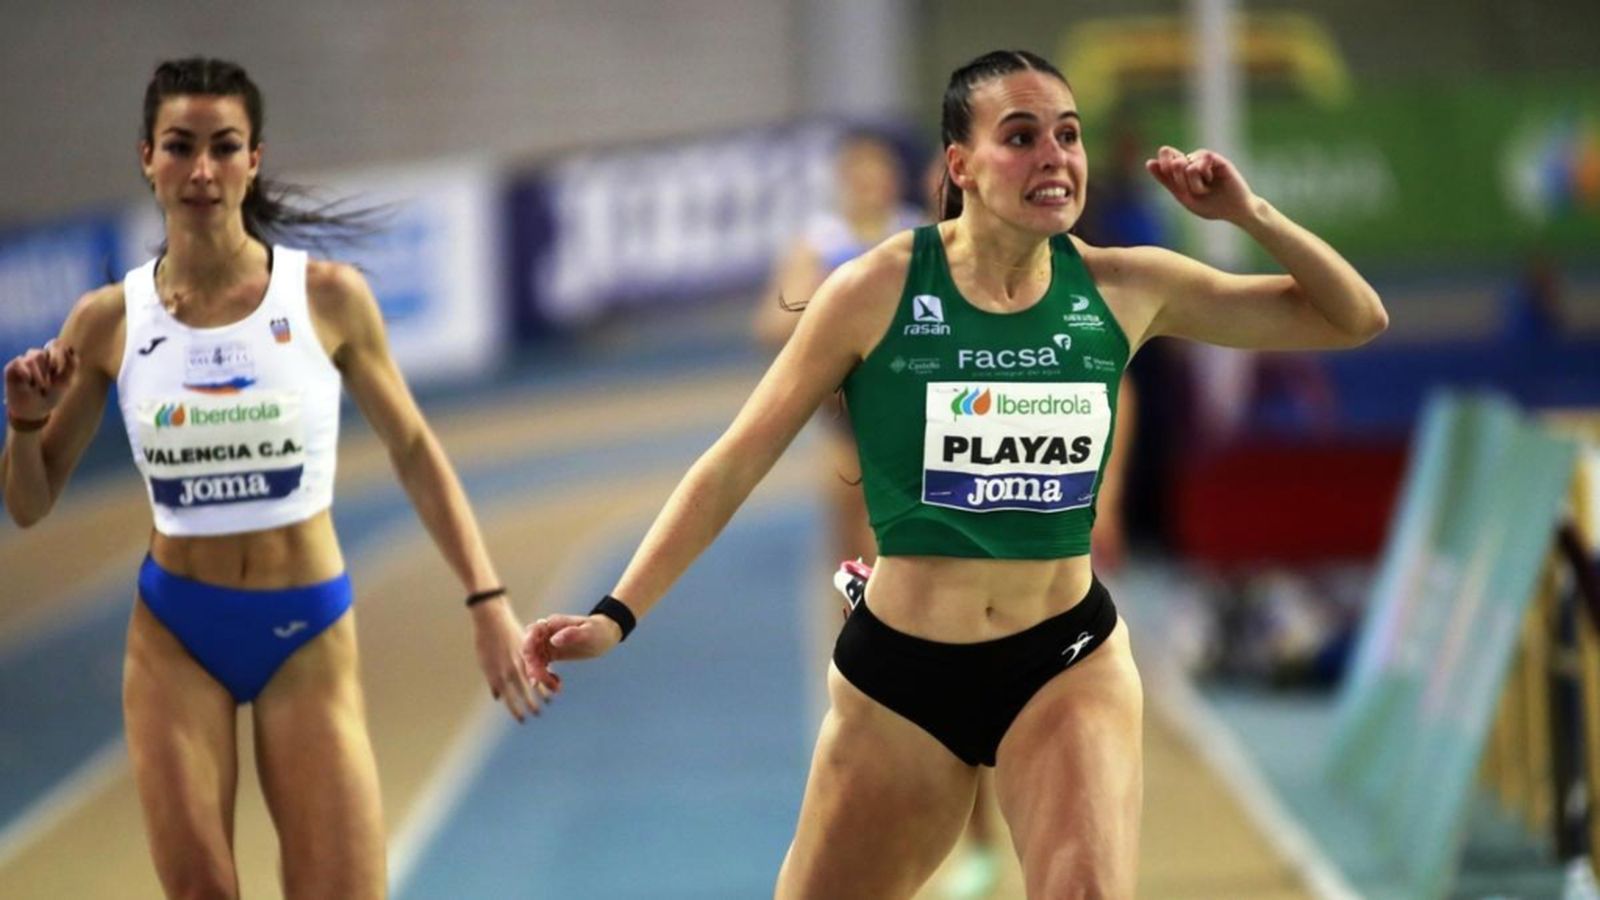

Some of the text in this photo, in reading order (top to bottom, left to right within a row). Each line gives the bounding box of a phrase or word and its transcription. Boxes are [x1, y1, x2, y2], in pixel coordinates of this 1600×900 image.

[190, 403, 280, 426] Iberdrola
[997, 394, 1092, 415] Iberdrola
[143, 439, 303, 465] VALENCIA C.A.
[943, 435, 1092, 464] PLAYAS
[179, 473, 270, 505] Joma
[967, 477, 1063, 505] Joma
